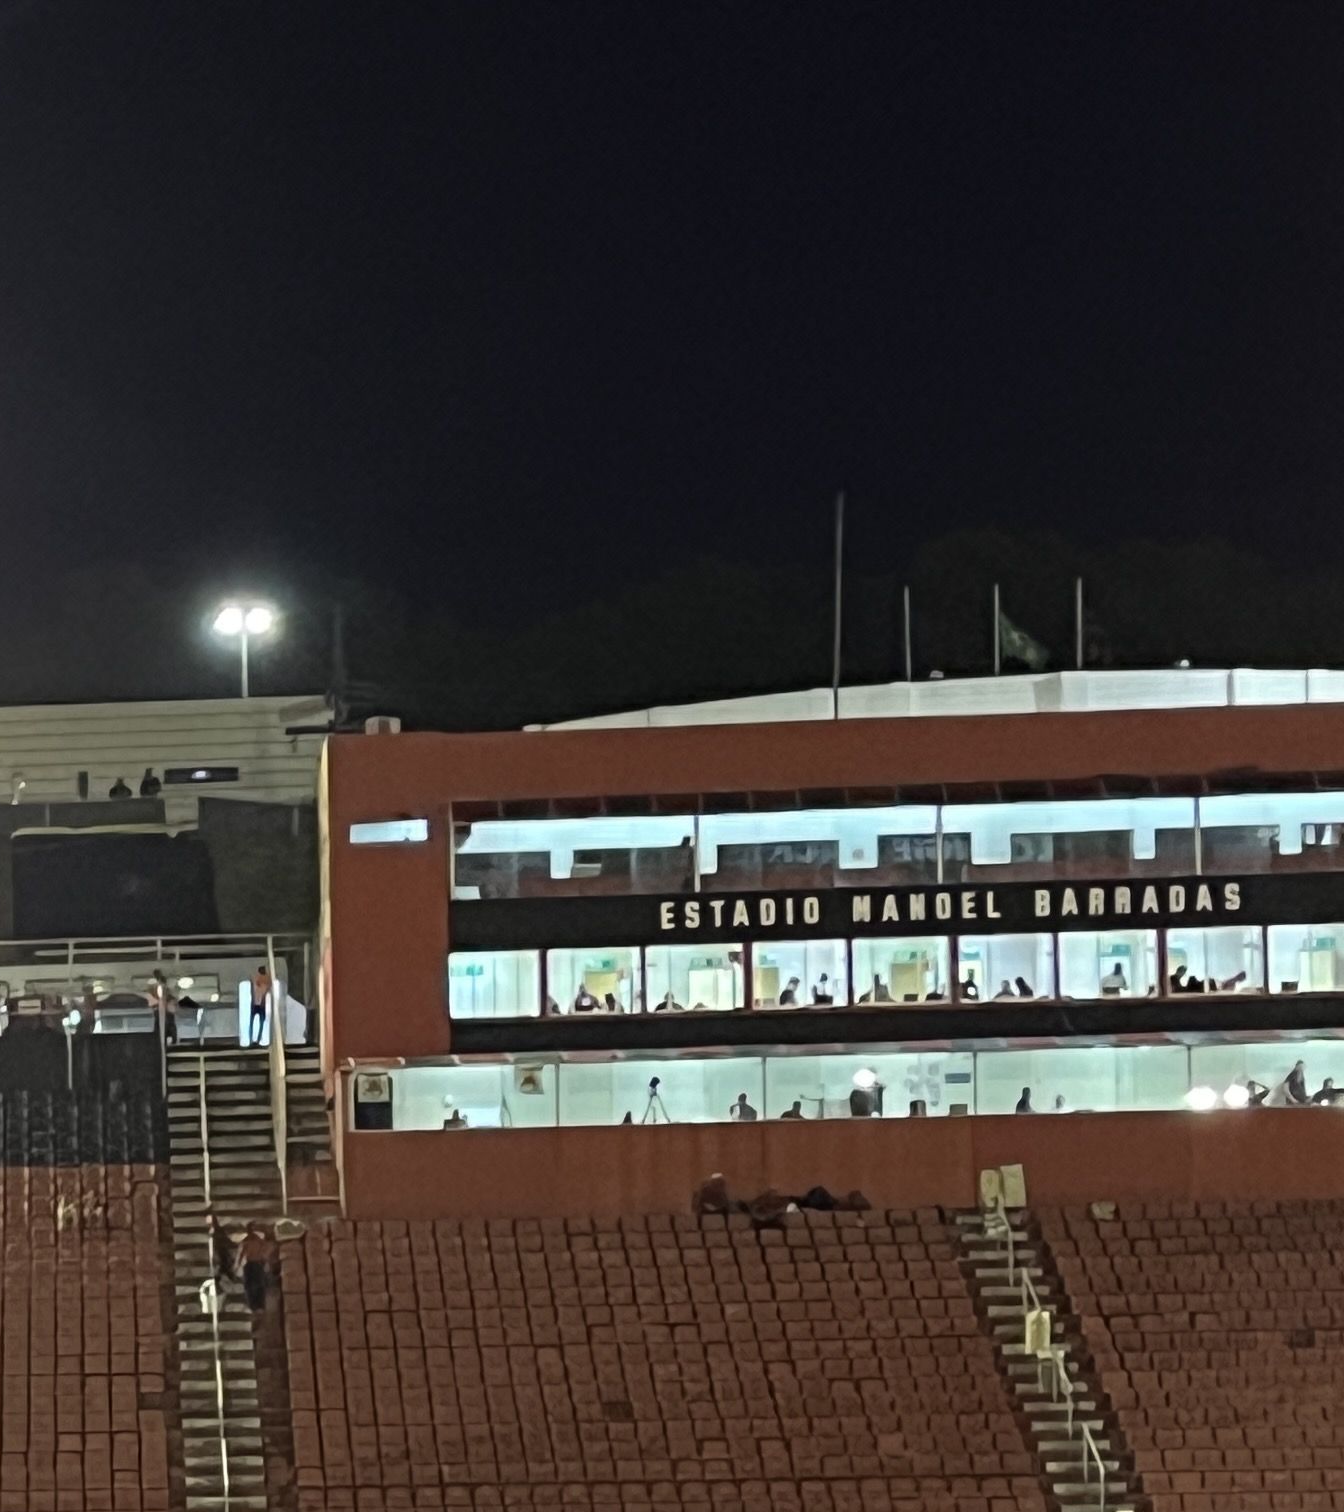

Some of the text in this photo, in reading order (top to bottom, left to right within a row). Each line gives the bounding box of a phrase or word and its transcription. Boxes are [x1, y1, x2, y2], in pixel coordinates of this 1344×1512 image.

[660, 882, 1242, 930] ESTADIO MANOEL BARRADAS
